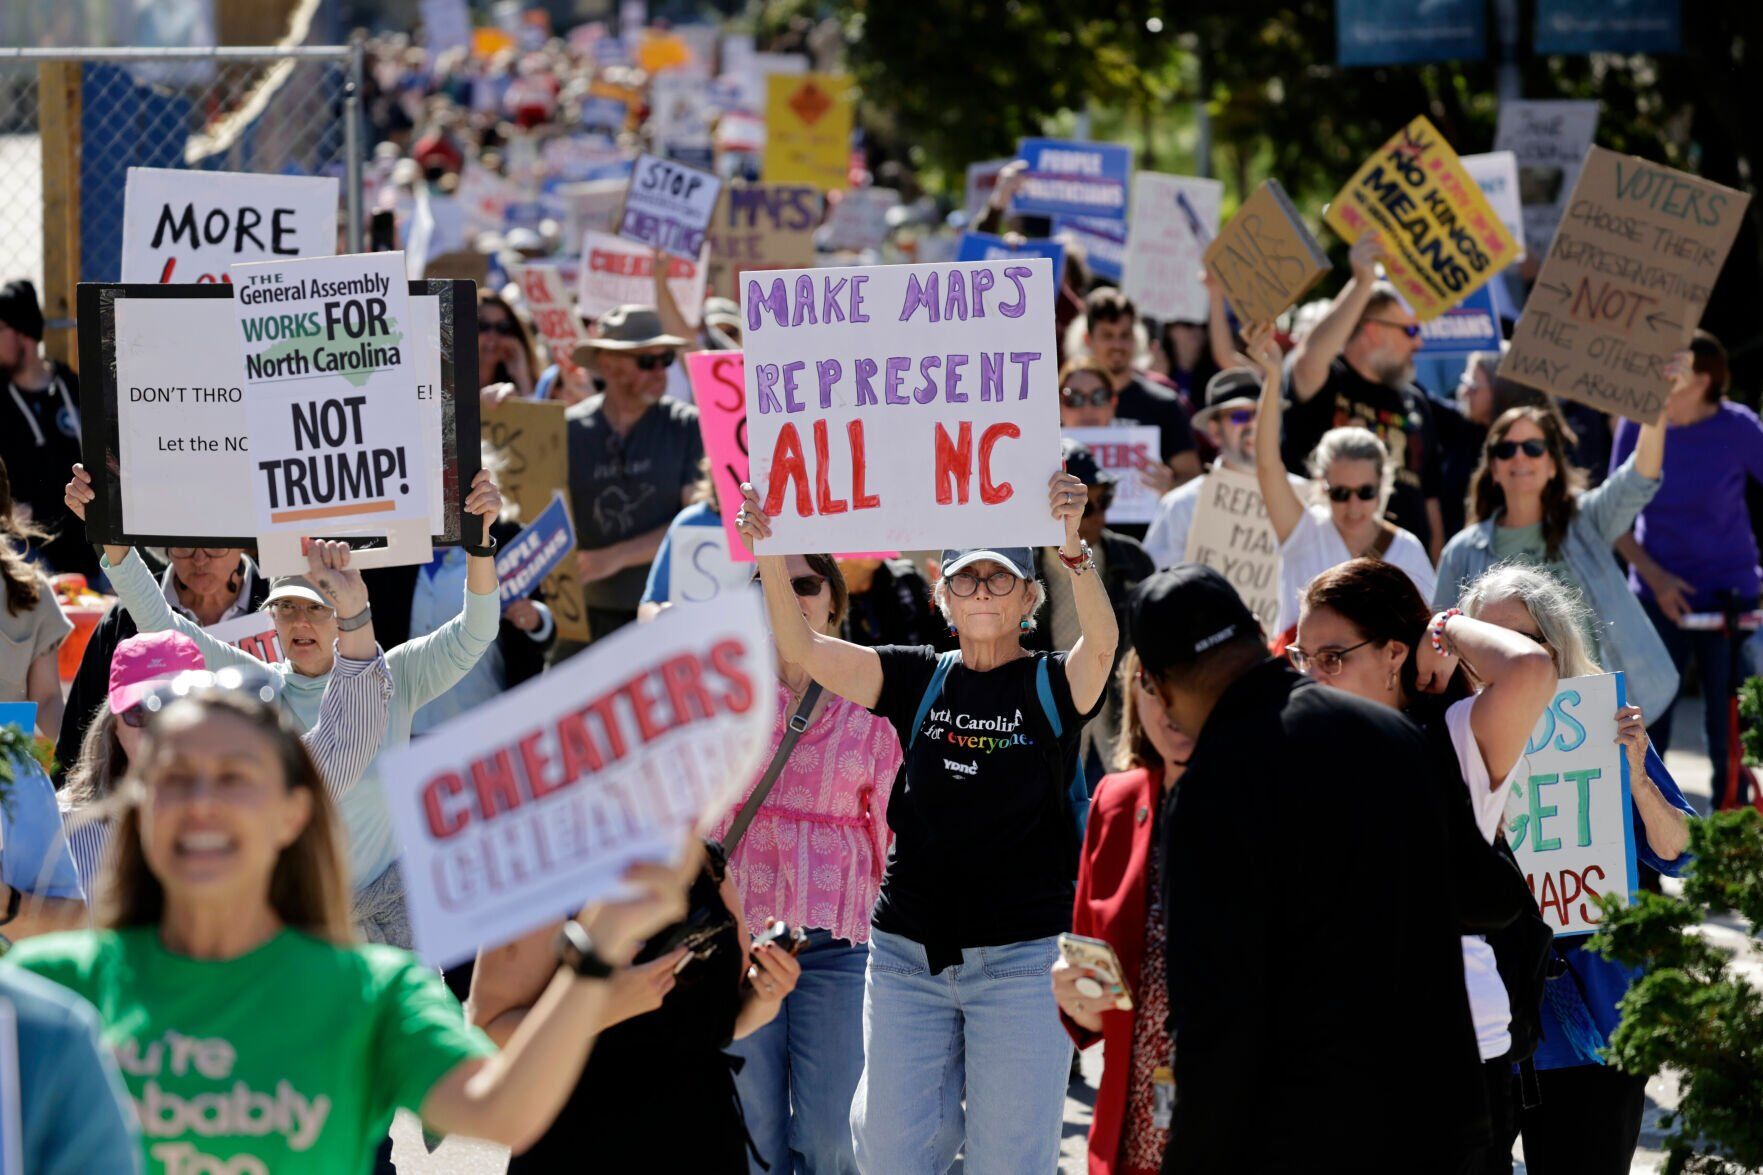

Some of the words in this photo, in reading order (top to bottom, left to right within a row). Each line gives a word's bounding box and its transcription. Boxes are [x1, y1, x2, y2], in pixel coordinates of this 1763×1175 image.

[642, 163, 704, 199] STOP
[1616, 160, 1727, 228] VOTERS
[151, 202, 299, 255] MORE
[1362, 166, 1471, 292] MEANS
[1387, 150, 1427, 188] NO
[1423, 188, 1491, 273] KINGS
[1569, 200, 1649, 244] CHOOSE
[1655, 225, 1718, 267] THEIR
[239, 279, 306, 305] General
[310, 272, 390, 299] Assembly
[248, 273, 284, 286] THE
[747, 274, 870, 331] MAKE
[899, 266, 1033, 322] MAPS
[1571, 276, 1660, 329] NOT
[241, 311, 322, 342] WORKS
[324, 297, 390, 341] FOR
[1531, 310, 1580, 350] THE
[246, 347, 309, 380] North
[312, 342, 402, 374] Carolina
[711, 358, 744, 412] S
[756, 352, 1042, 414] REPRESENT
[1512, 352, 1569, 386] WAY
[130, 387, 187, 403] DON'T
[192, 387, 243, 403] THRO
[417, 385, 433, 400] E!
[158, 436, 184, 451] Let
[190, 436, 218, 451] the
[291, 396, 367, 451] NOT
[259, 446, 409, 508] TRUMP!
[763, 418, 881, 517] ALL
[934, 421, 1021, 506] NC
[1086, 442, 1150, 470] TERS
[496, 530, 540, 577] OPLE
[1229, 524, 1273, 556] MA
[1221, 554, 1274, 590] YOU
[421, 638, 755, 841] CHEATERS
[1525, 689, 1587, 755] DS
[140, 1080, 333, 1152] bably
